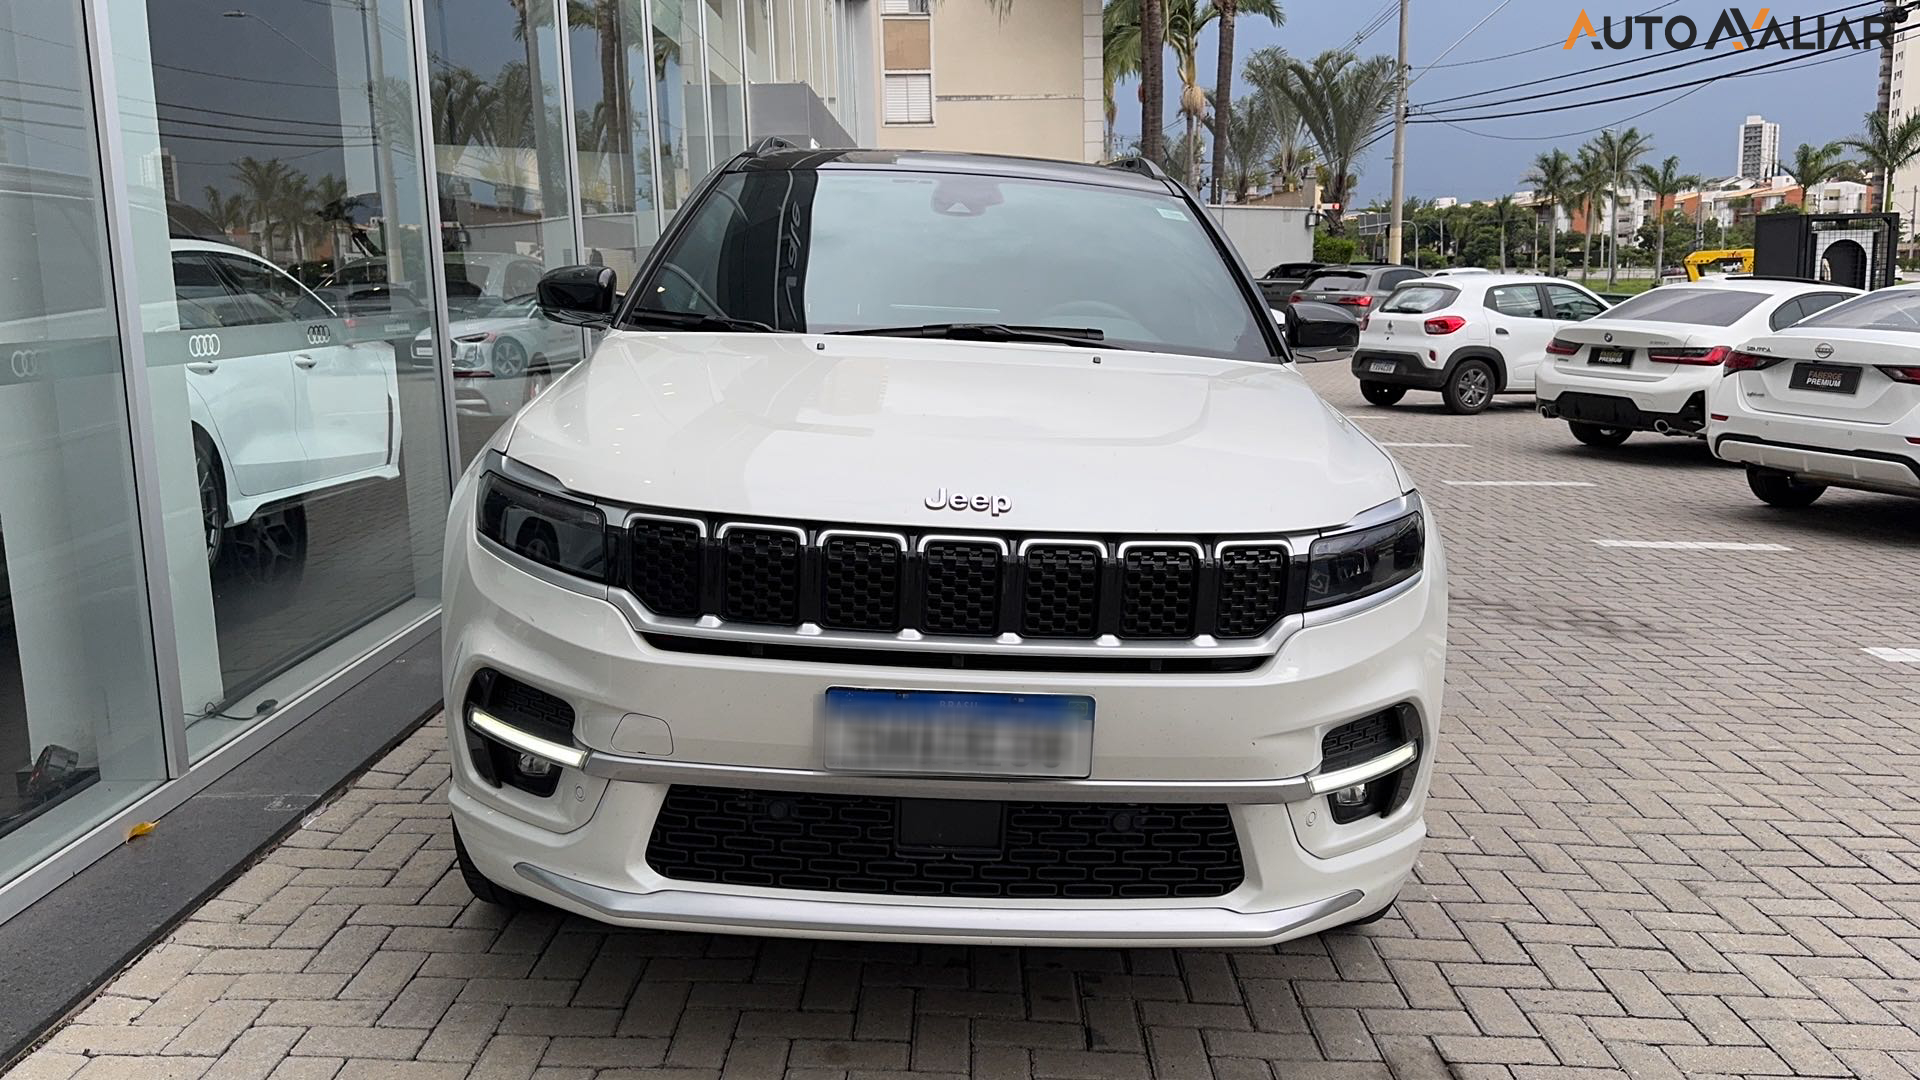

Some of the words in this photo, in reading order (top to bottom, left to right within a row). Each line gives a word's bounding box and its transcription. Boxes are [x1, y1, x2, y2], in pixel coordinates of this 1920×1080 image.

[1808, 370, 1843, 380] FABERGE
[1806, 377, 1841, 387] PREMIUM
[924, 487, 1012, 517] Jeep
